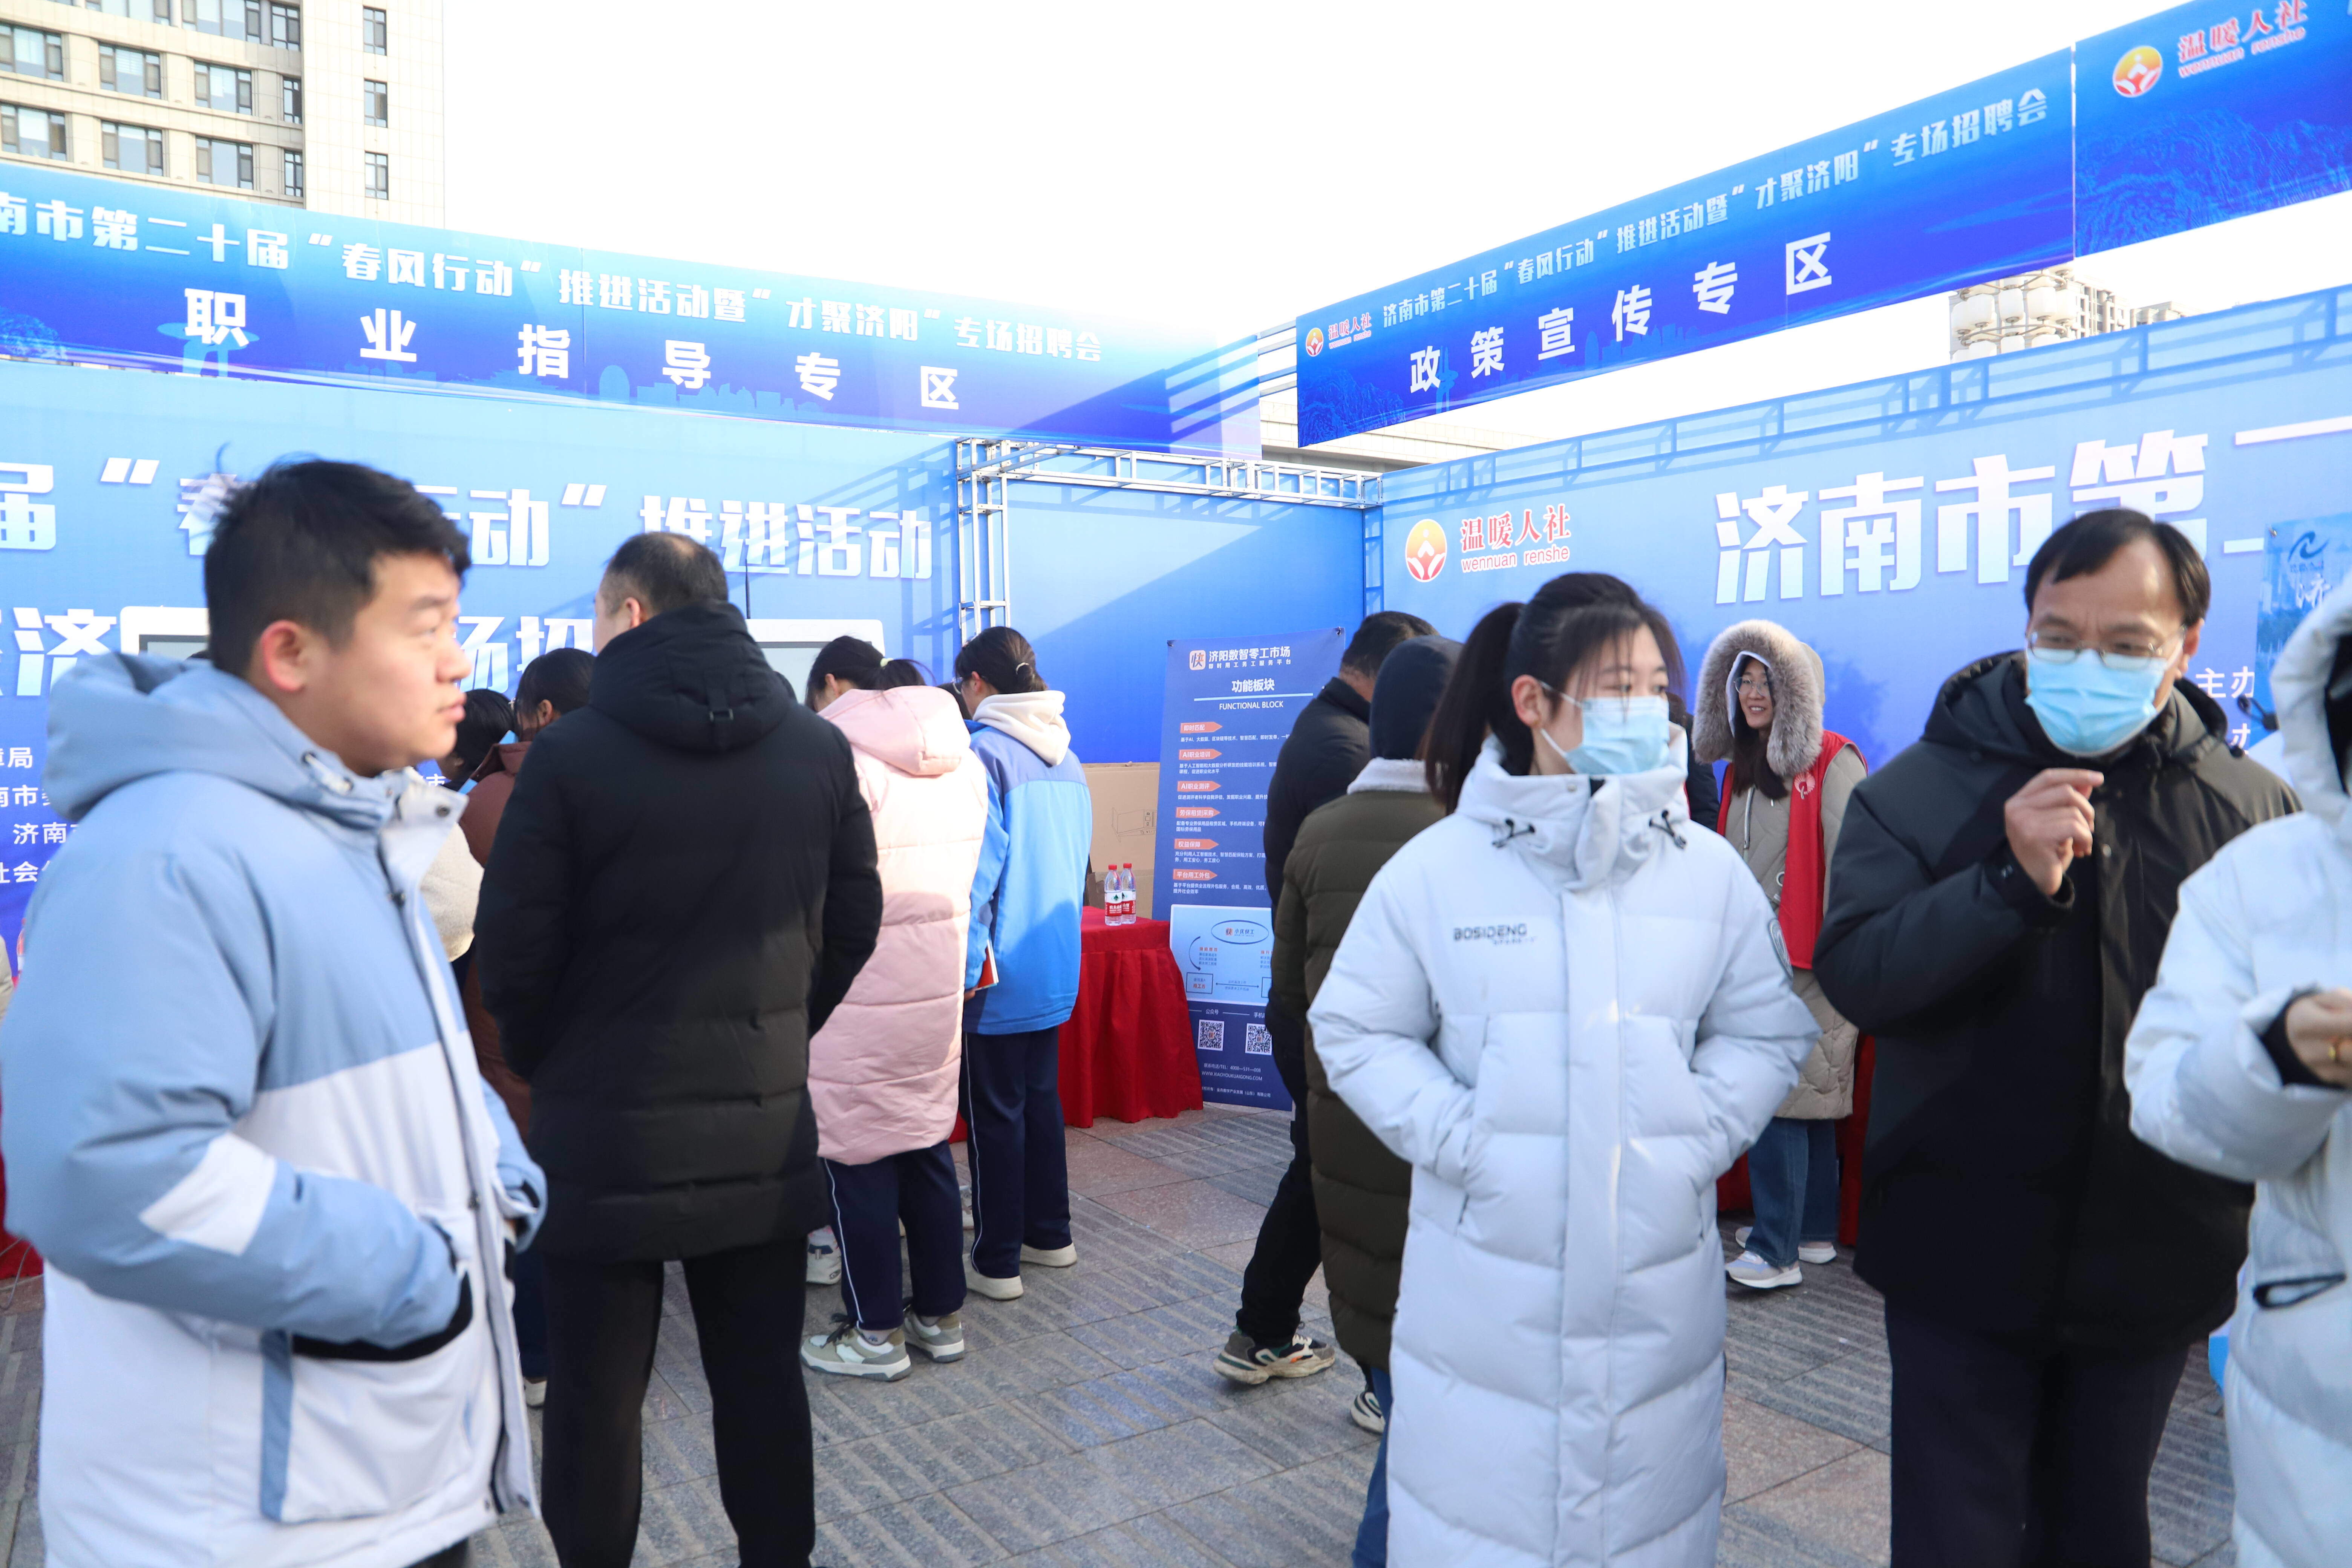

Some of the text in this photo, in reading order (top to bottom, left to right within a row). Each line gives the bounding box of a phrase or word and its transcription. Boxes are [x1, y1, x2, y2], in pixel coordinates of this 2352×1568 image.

[2178, 0, 2308, 63] 温暖人社
[1328, 312, 1372, 340] 温暖人社
[1410, 232, 1832, 394] 政策宣传专区
[185, 288, 960, 410] 职业指导专区
[1329, 330, 1372, 349] wennuan renshe
[1460, 503, 1571, 553] 温暖人社
[1461, 544, 1570, 573] wennuan renshe
[1209, 646, 1291, 662] 济阳数智零工市场
[1231, 678, 1275, 693] 功能板块
[1219, 701, 1283, 710] FUNCTIONAL BLOCK
[1453, 923, 1527, 942] BOSIDENG
